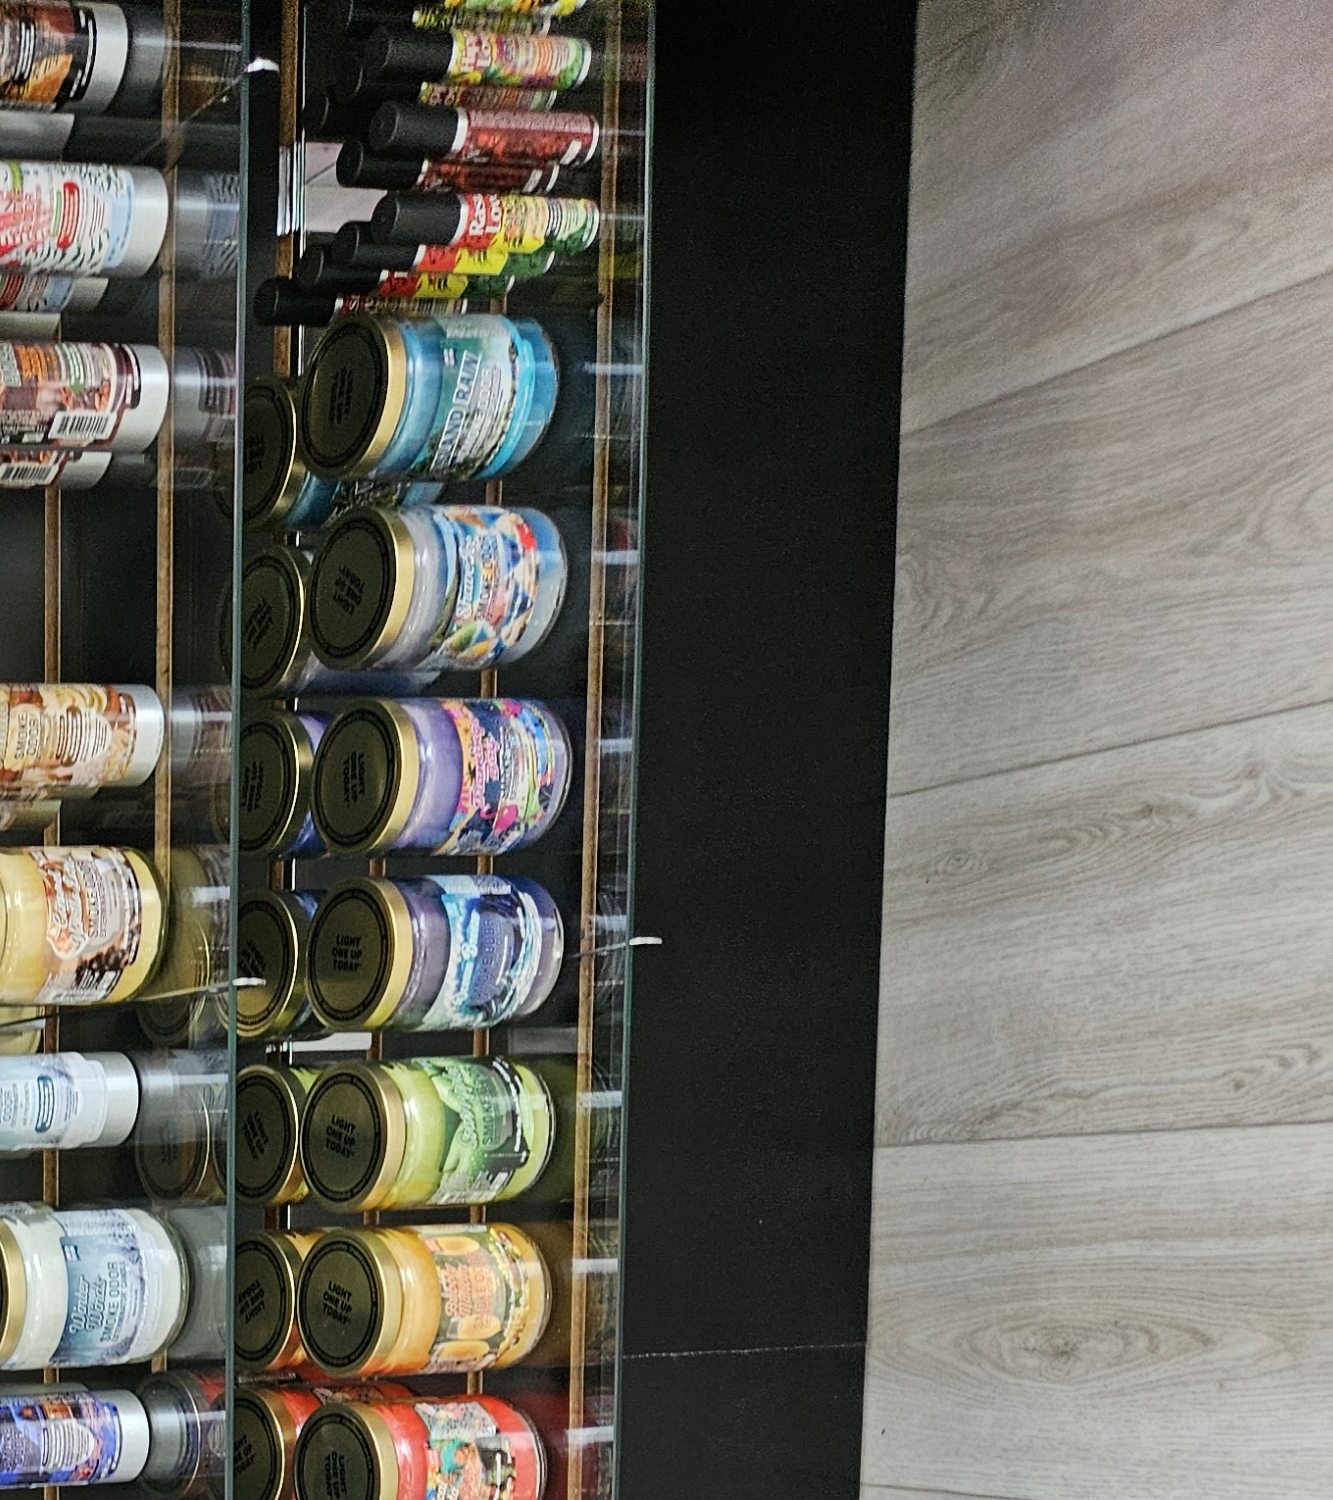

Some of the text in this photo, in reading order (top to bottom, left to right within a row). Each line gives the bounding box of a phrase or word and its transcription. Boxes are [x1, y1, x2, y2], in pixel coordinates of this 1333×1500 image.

[454, 352, 479, 400] RAIN
[15, 713, 27, 760] SMOKE
[2, 1091, 13, 1122] ODOR
[68, 1275, 88, 1334] Winter
